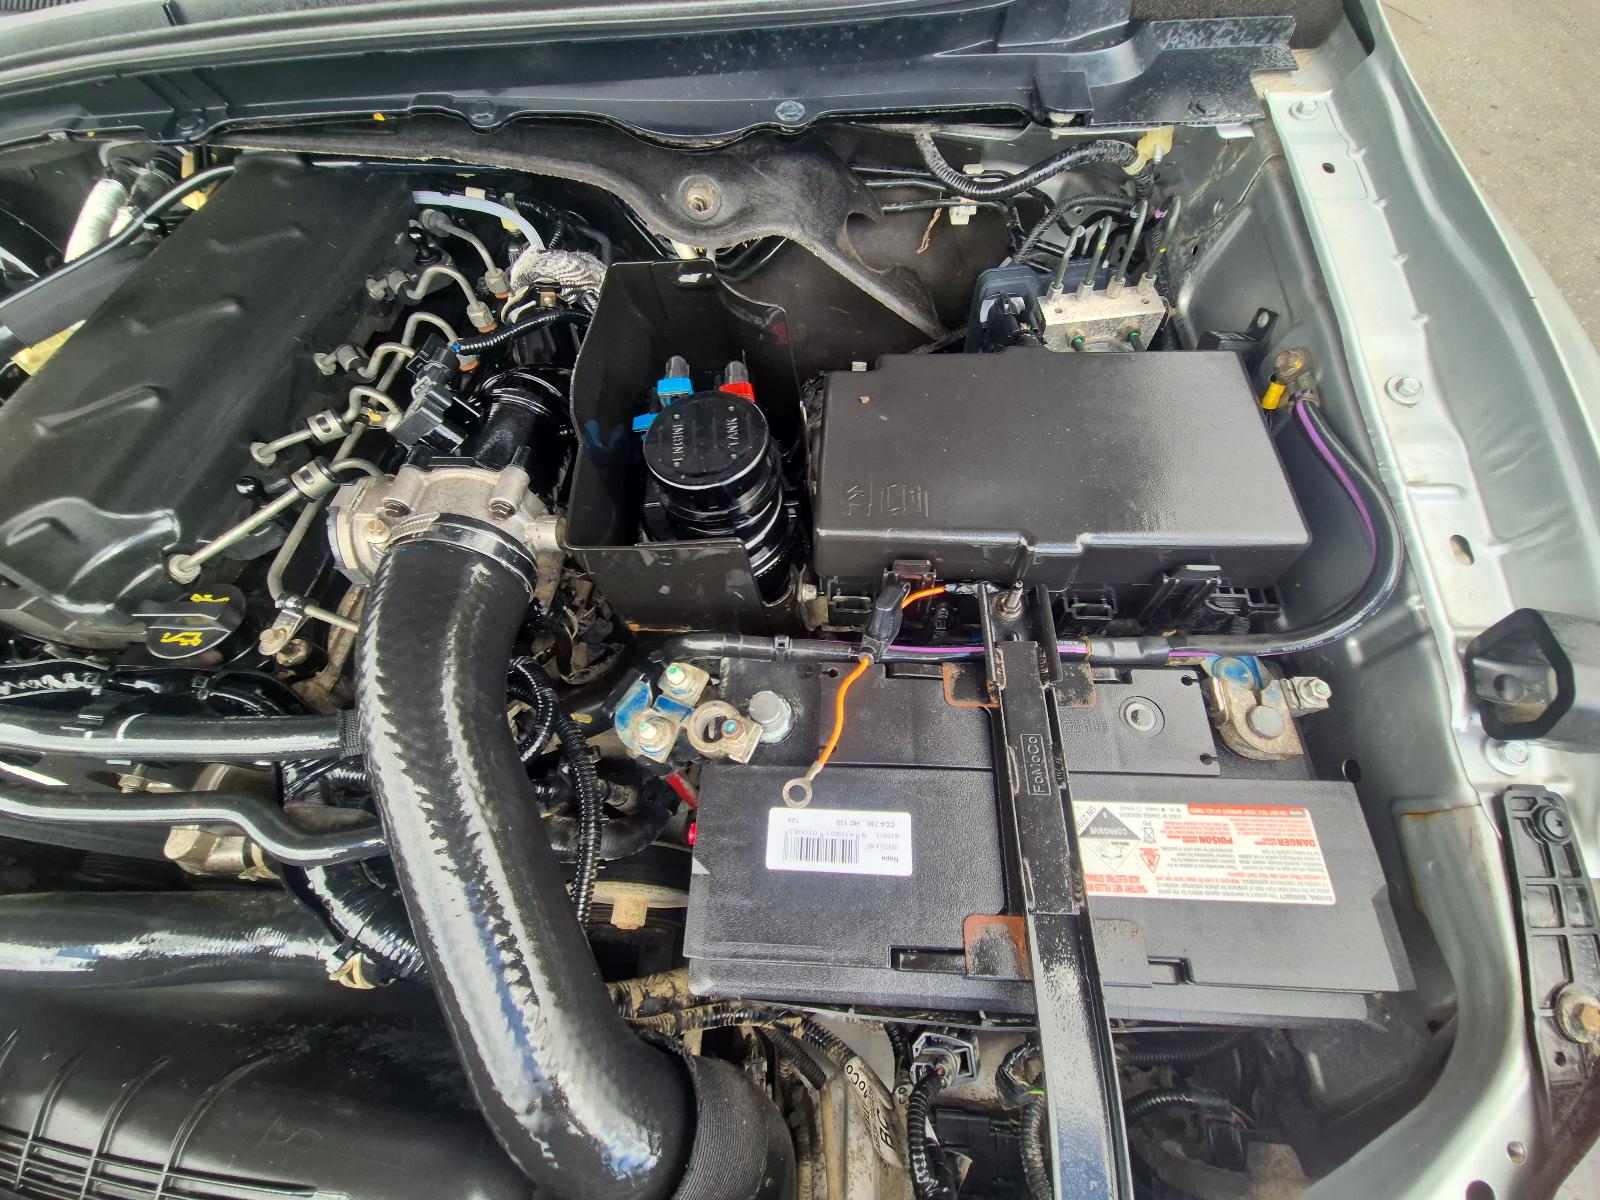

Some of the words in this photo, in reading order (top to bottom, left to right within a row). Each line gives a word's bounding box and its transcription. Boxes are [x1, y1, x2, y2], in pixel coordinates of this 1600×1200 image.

[726, 417, 739, 449] TANK
[848, 819, 860, 827] RC
[1089, 827, 1128, 836] CORROSIVE
[1198, 836, 1233, 844] POISON
[1276, 838, 1316, 848] DANGER
[881, 855, 899, 863] Napa
